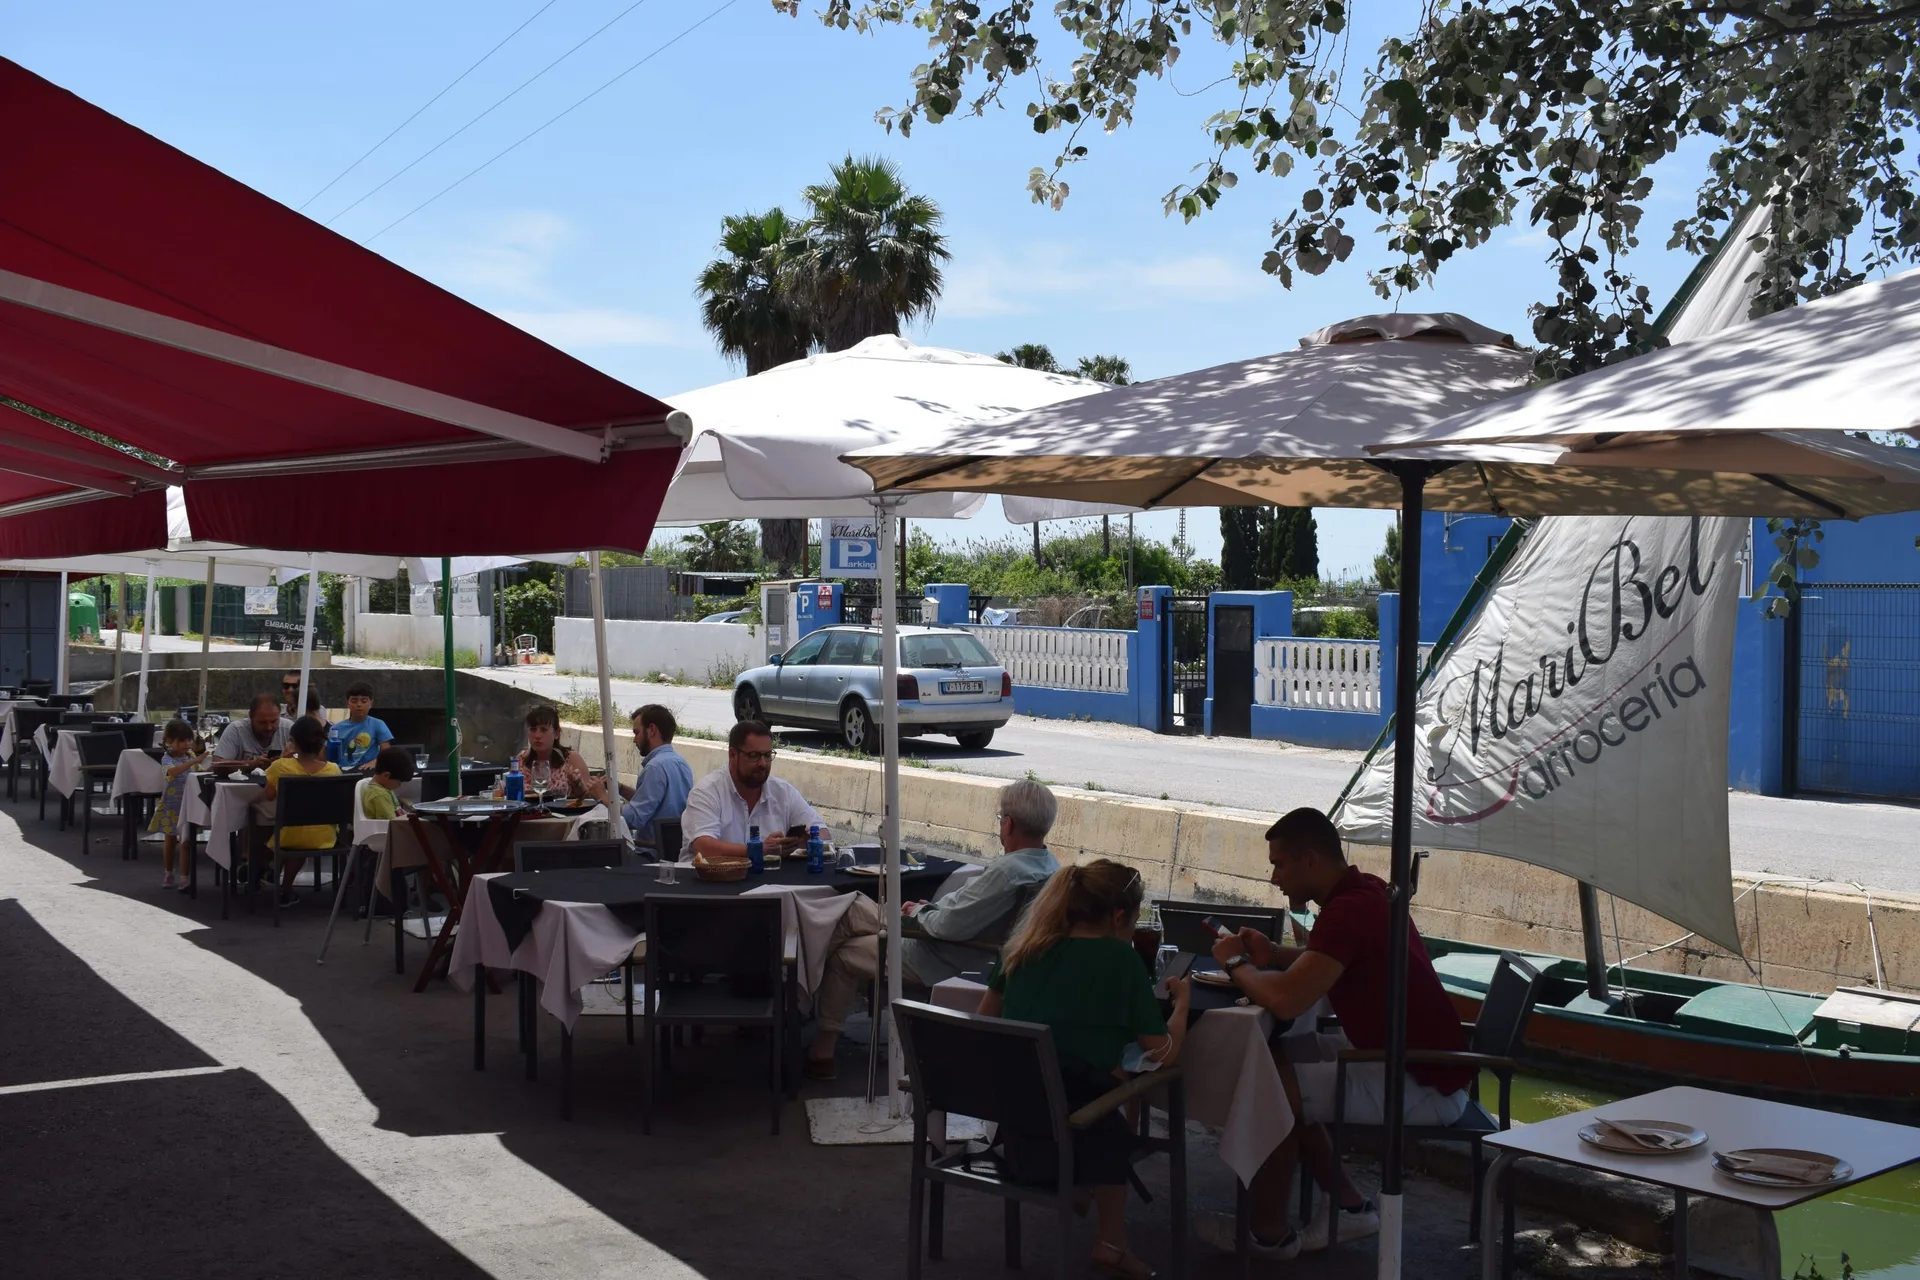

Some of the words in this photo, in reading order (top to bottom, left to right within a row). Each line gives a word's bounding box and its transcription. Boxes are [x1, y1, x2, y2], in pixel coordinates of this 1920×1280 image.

[839, 540, 876, 569] Parking
[802, 595, 809, 613] P
[264, 619, 318, 634] EMBARCADO
[1427, 516, 1716, 781] MariBel
[1522, 655, 1707, 800] arrocería
